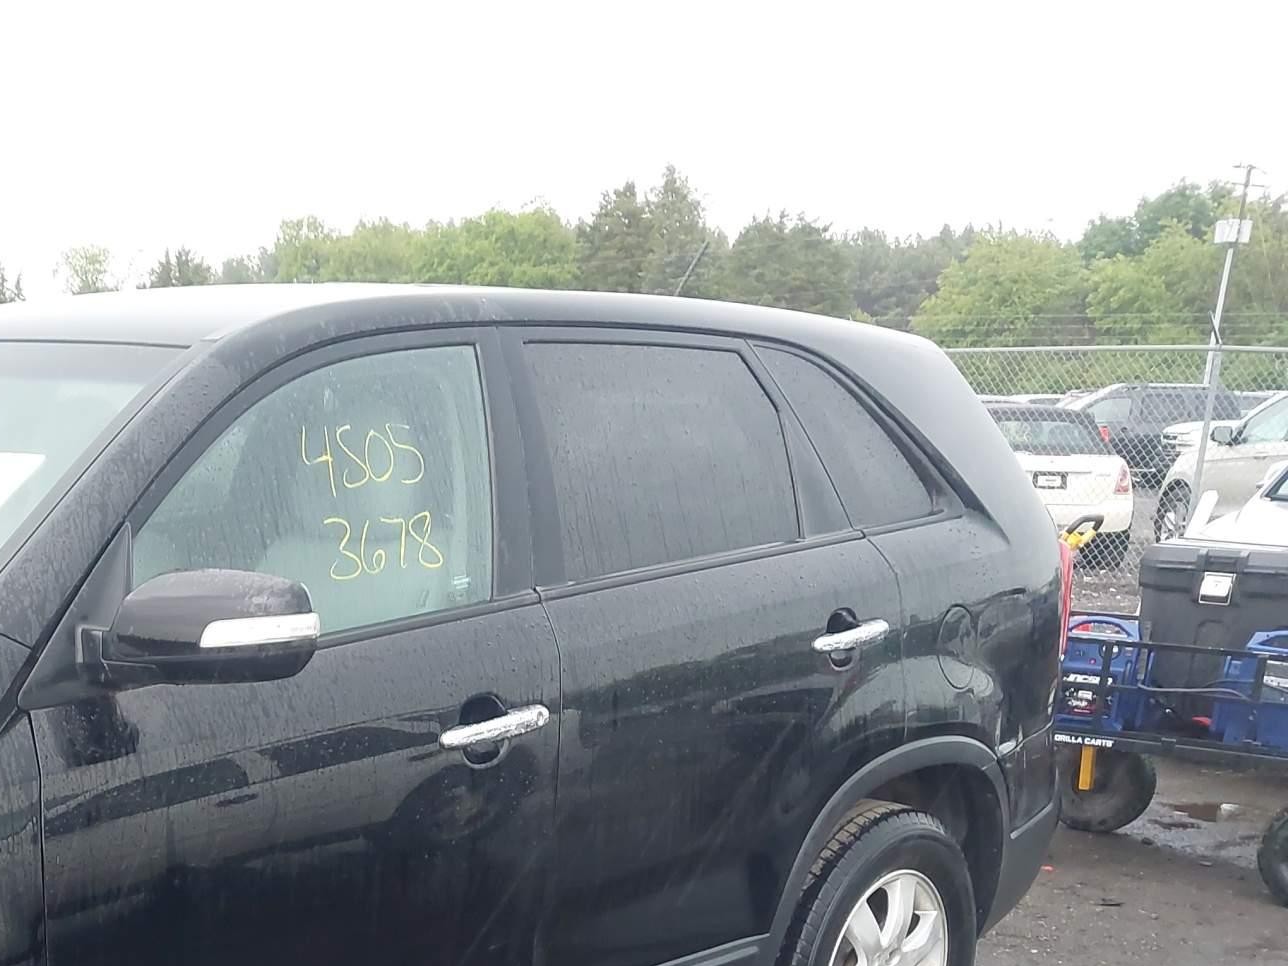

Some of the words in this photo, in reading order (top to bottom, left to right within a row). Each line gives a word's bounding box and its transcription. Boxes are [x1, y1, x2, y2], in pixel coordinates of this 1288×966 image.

[300, 423, 425, 498] 4505
[323, 511, 444, 580] 3678
[1054, 733, 1083, 745] ORILLA
